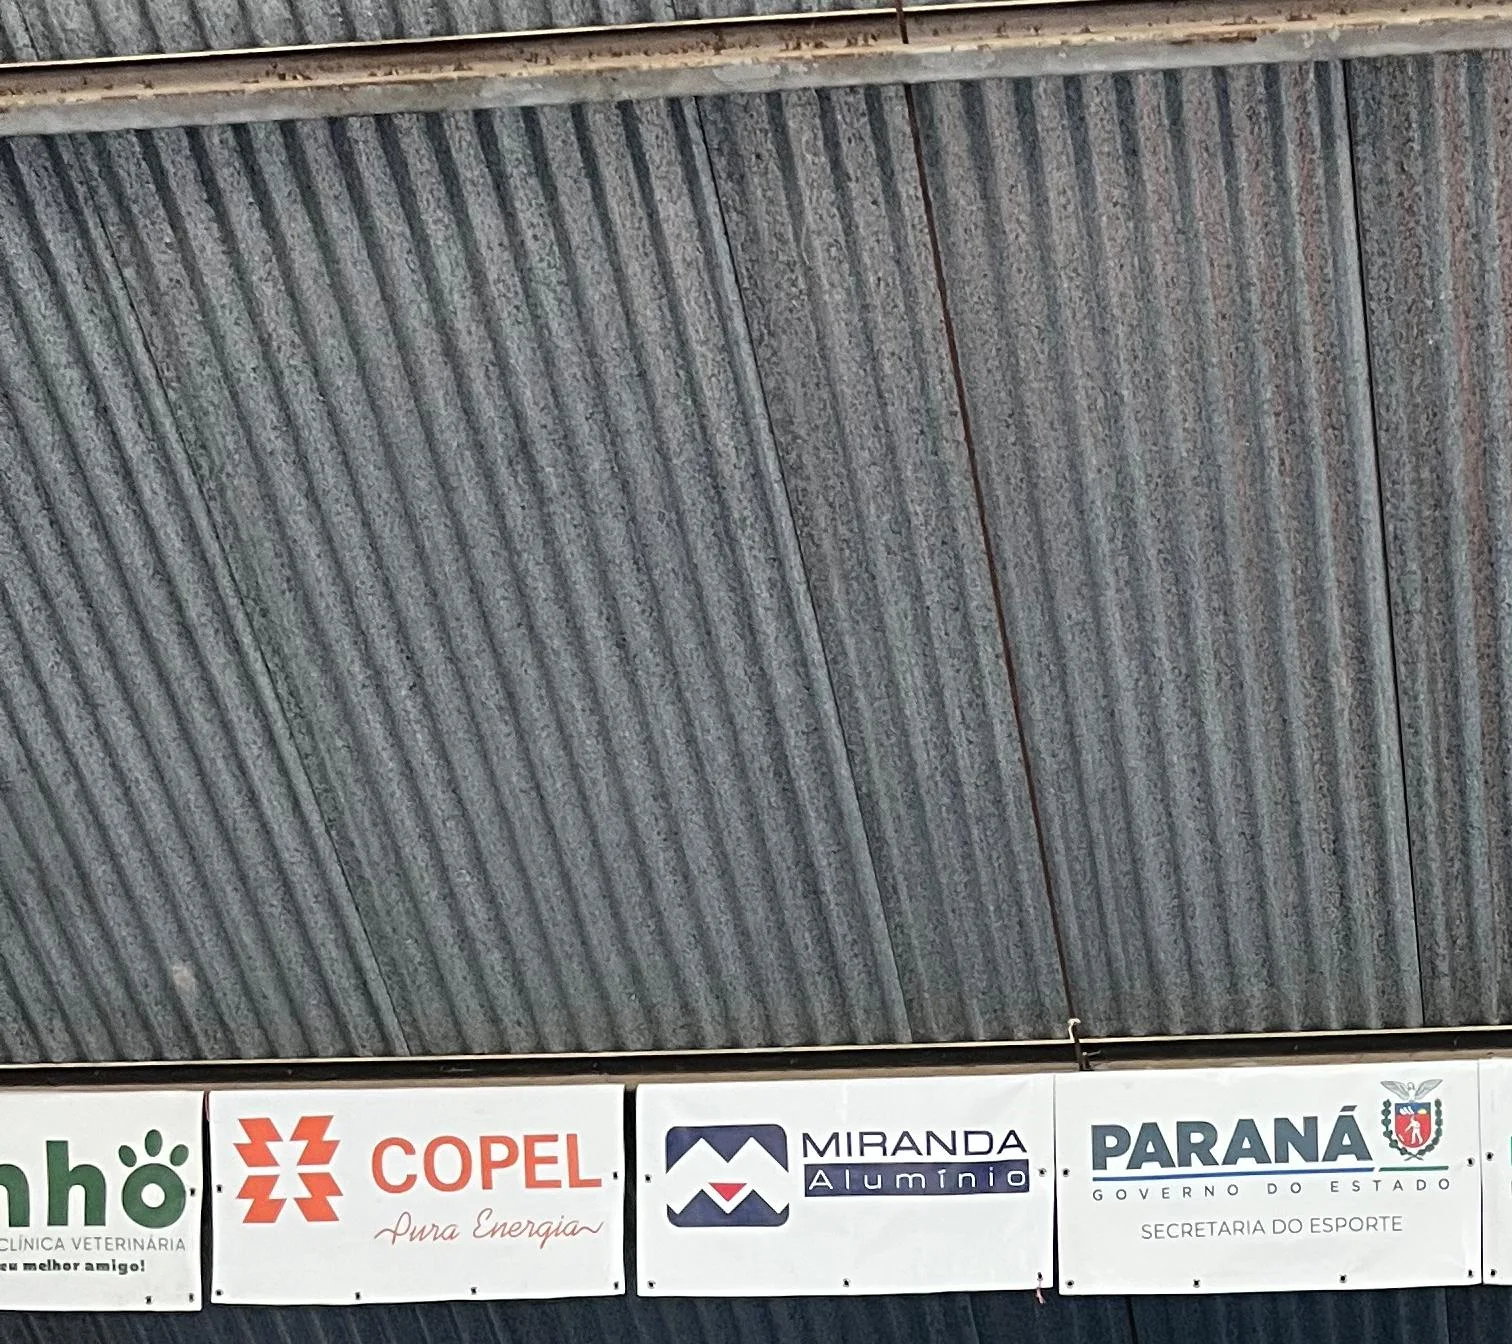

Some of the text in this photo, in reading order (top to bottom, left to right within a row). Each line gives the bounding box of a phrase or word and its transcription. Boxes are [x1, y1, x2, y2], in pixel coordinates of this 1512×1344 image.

[802, 1129, 1027, 1158] MIRANDA
[1091, 1104, 1373, 1171] PARANÁ
[371, 1133, 602, 1193] COPEL
[808, 1166, 1027, 1192] Alumínio
[1093, 1178, 1450, 1201] GOVERNO DO ESTADO
[374, 1208, 603, 1250] Pura Energia
[1141, 1215, 1403, 1240] SECRETARIA DO ESPORTE
[72, 1235, 186, 1251] VETERINÁRIA
[23, 1259, 80, 1272] melhor
[84, 1259, 145, 1275] amigo!
